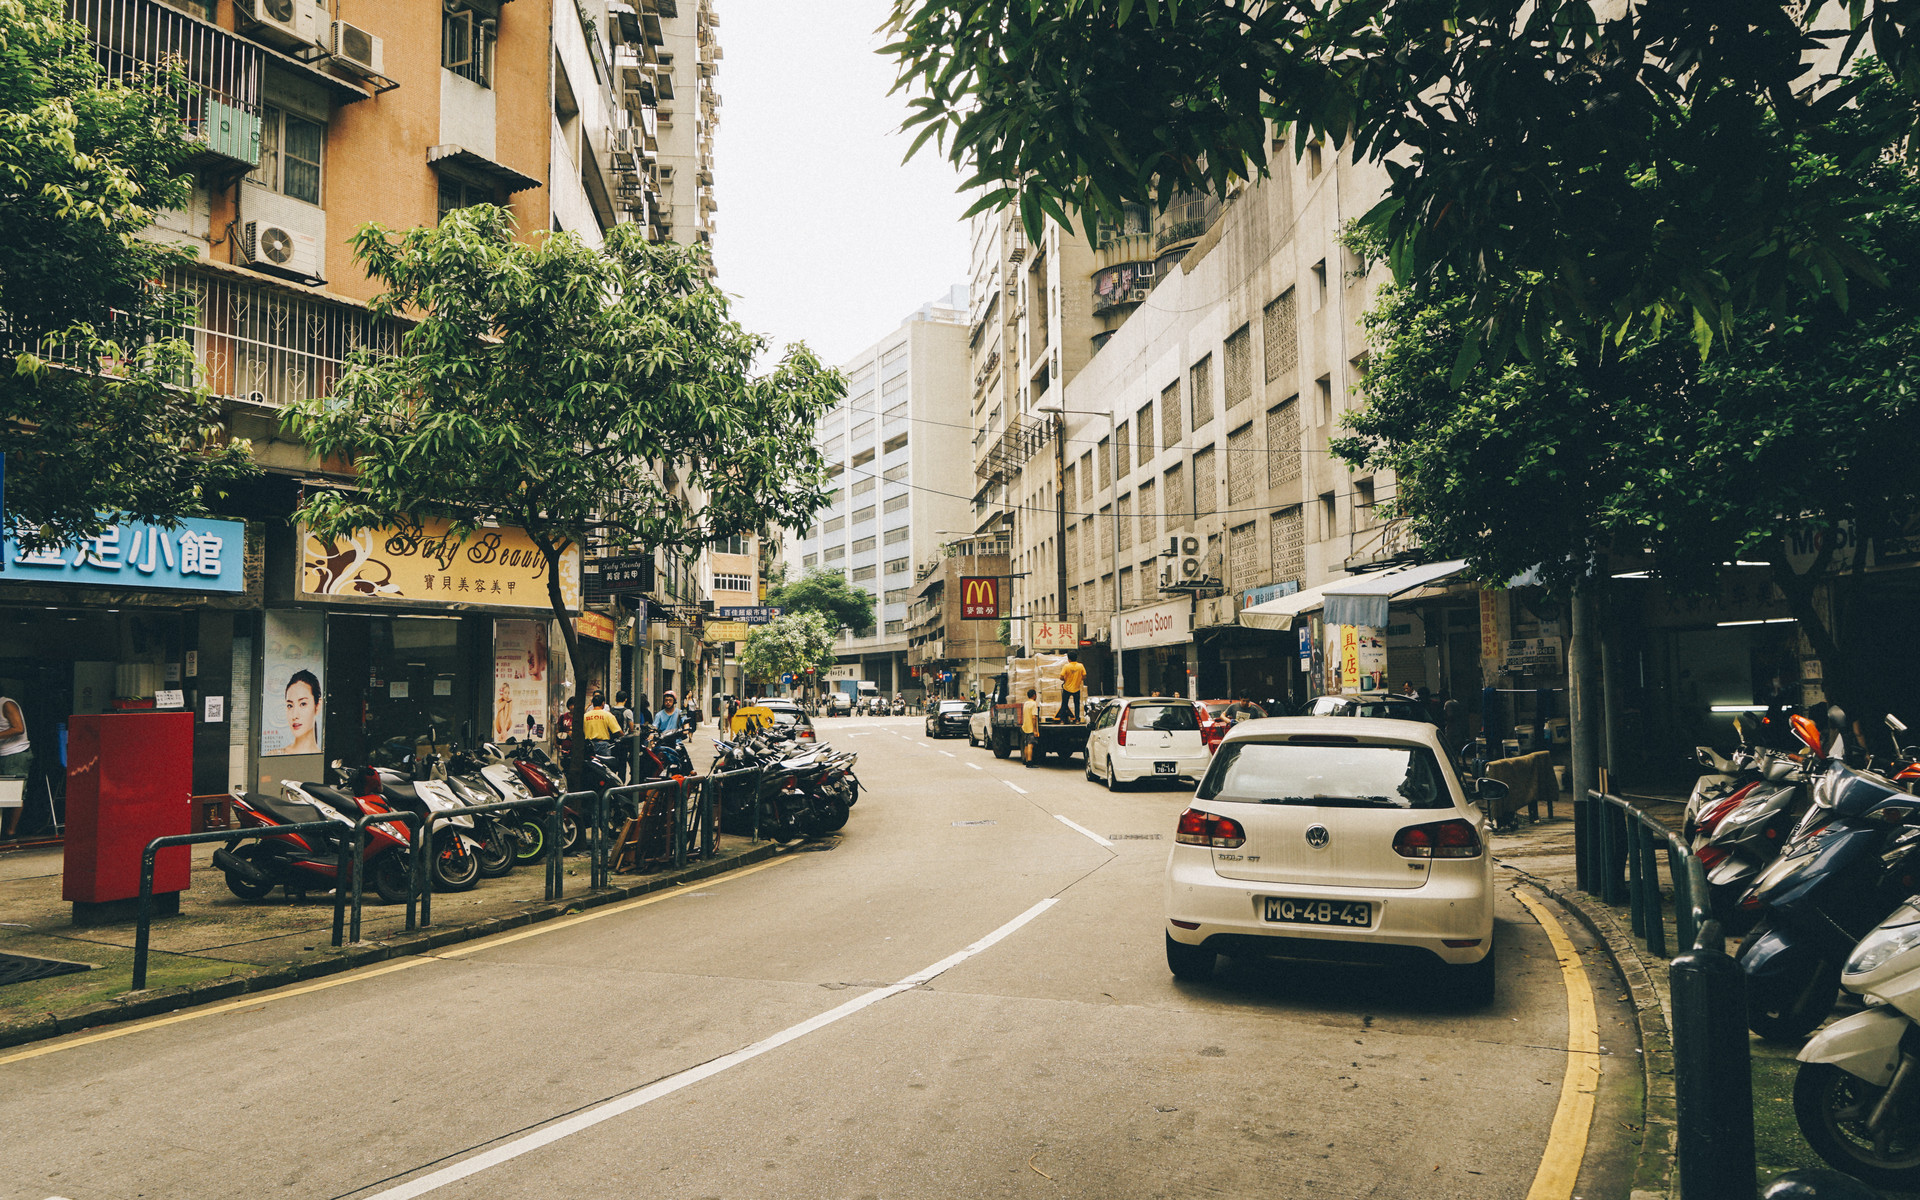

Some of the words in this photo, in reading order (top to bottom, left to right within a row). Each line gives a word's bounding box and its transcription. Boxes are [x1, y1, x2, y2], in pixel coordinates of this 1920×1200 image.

[467, 533, 549, 580] Beauty
[424, 574, 516, 595] 寶貝美容美甲
[966, 606, 994, 615] 麥當勞
[1039, 622, 1074, 640] 永興
[1125, 617, 1154, 637] Comming
[1154, 612, 1173, 632] Soon
[1266, 898, 1370, 926] MQ-48-43
